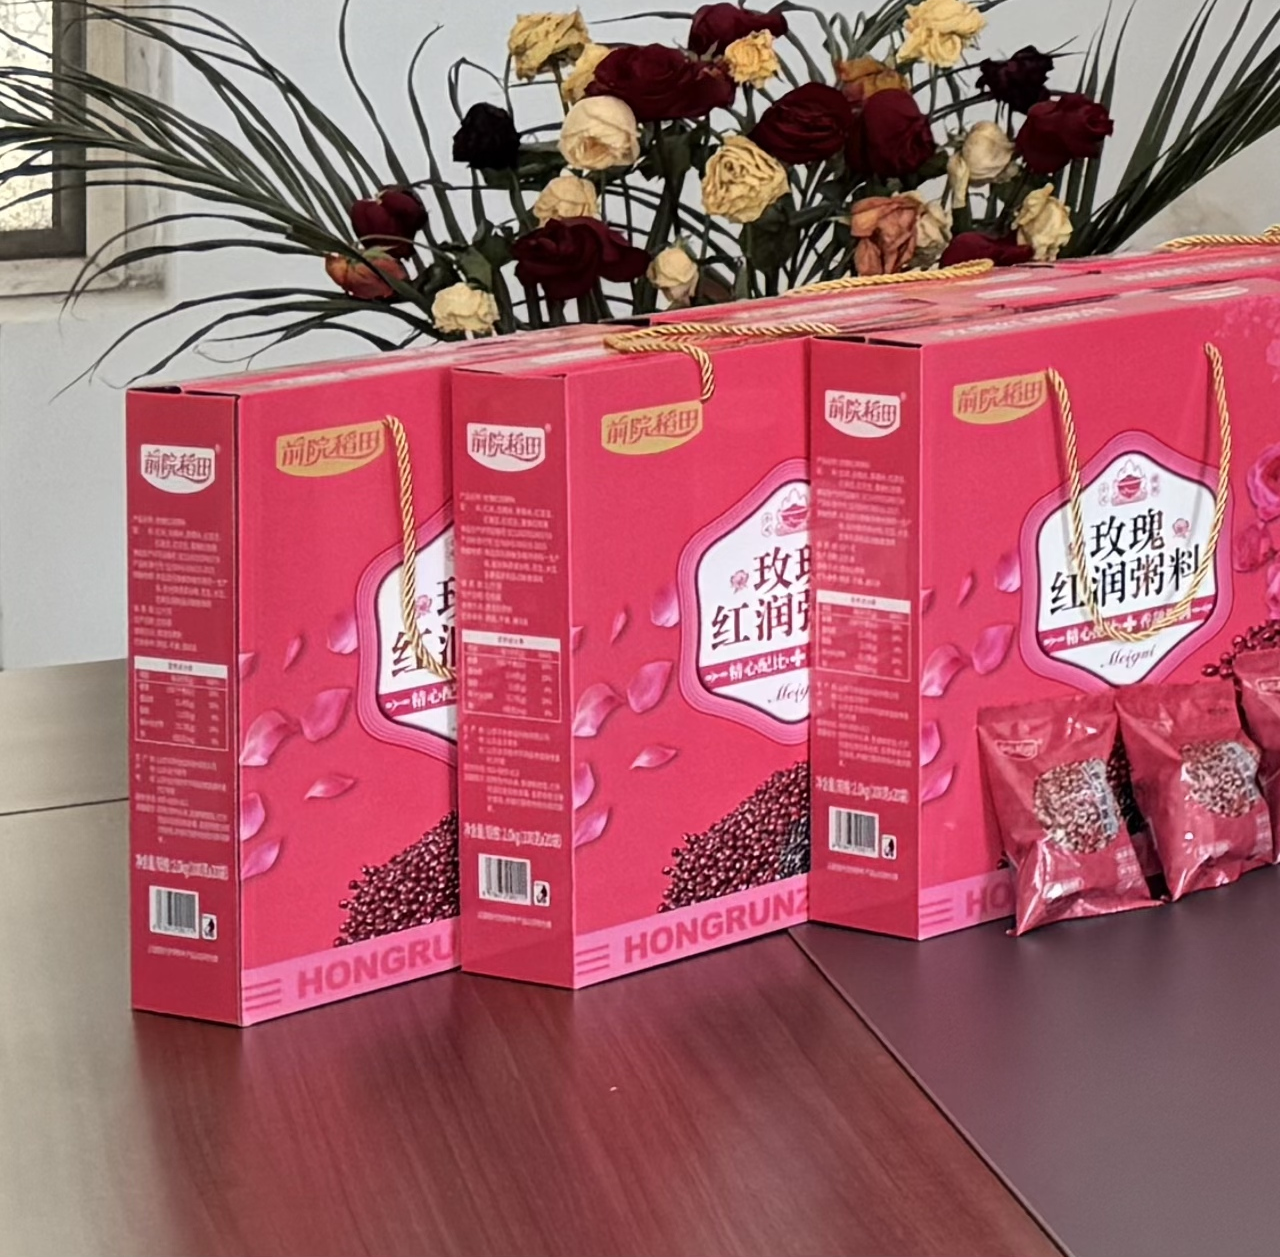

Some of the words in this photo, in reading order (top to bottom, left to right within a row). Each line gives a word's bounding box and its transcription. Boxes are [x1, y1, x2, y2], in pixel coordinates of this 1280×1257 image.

[828, 394, 897, 429] 前院稻田
[957, 379, 1044, 415] 前院稻田
[471, 427, 542, 463] 前院稻田
[607, 408, 699, 446] 前院稻田
[143, 448, 212, 485] 前院稻田
[281, 429, 380, 467] 前院稻田
[1090, 507, 1165, 561] 玫瑰
[1050, 544, 1200, 616] 红润粥料
